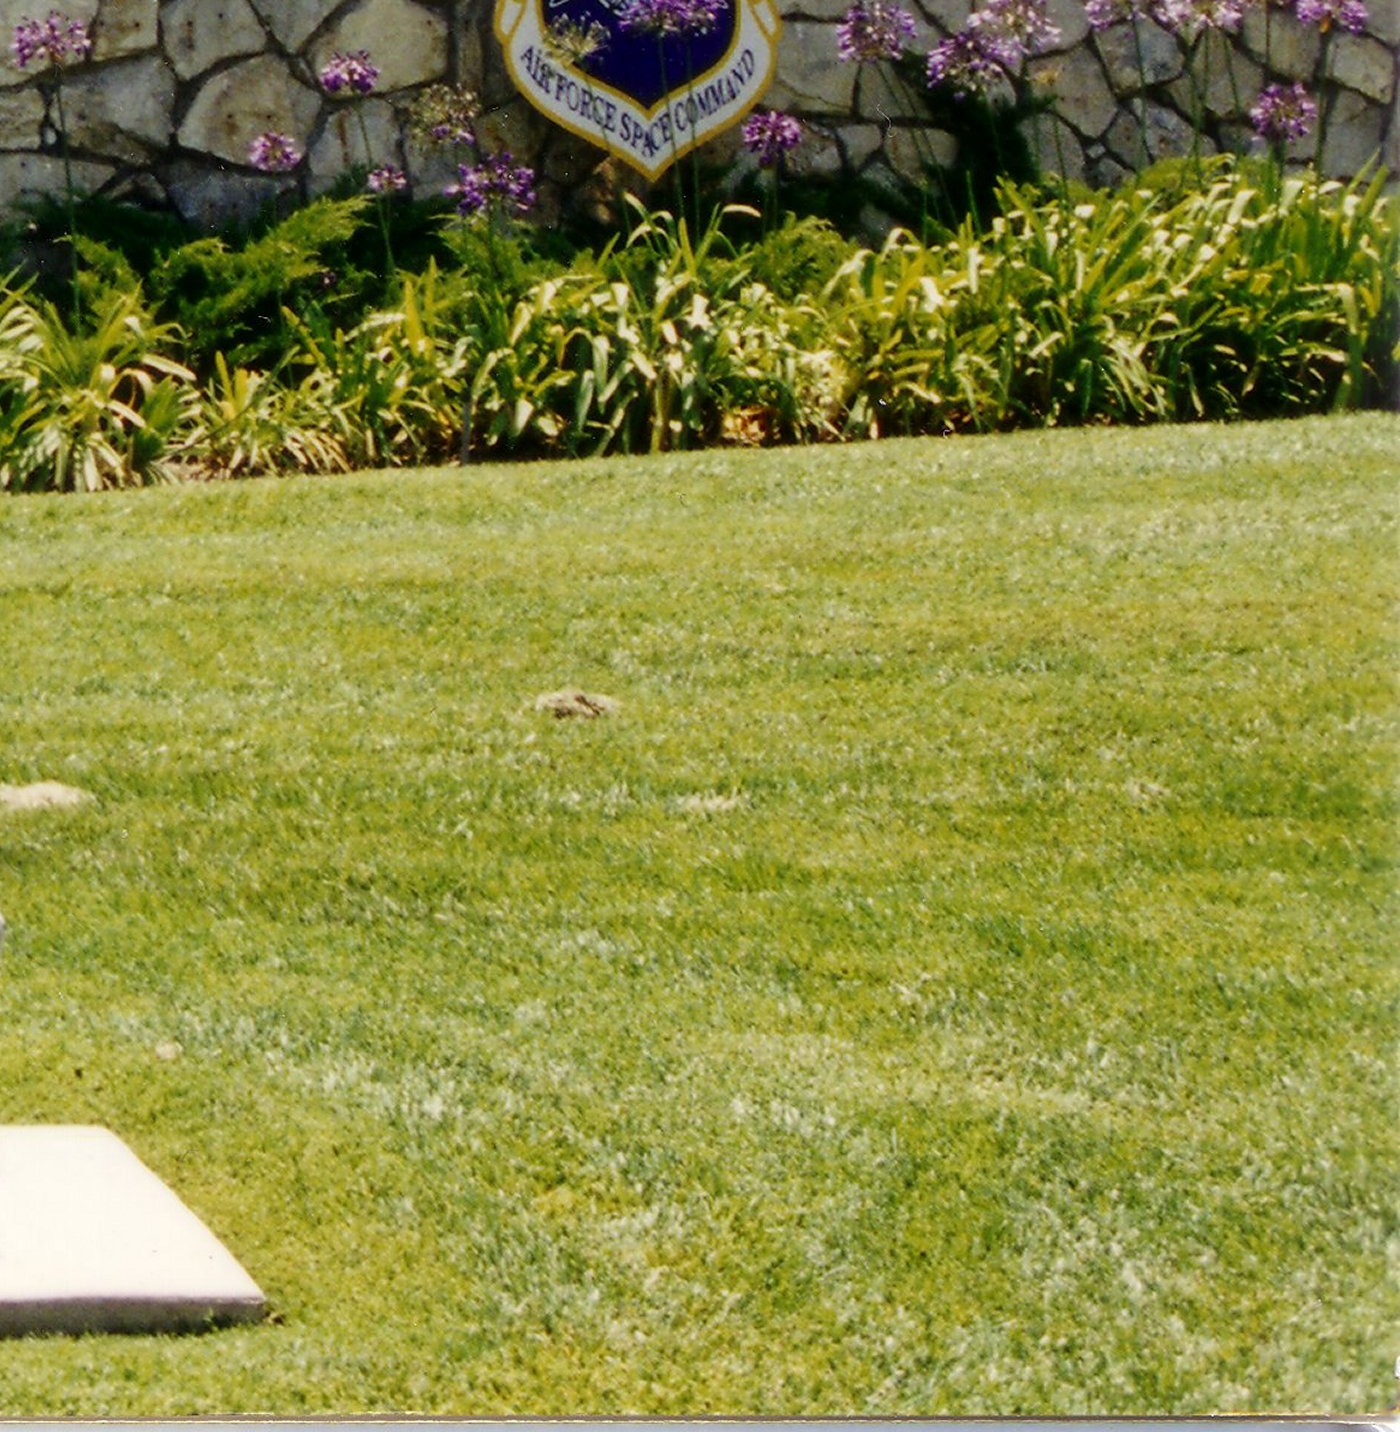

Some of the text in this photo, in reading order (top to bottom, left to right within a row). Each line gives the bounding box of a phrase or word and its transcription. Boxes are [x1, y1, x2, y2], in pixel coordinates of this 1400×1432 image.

[520, 46, 756, 158] AIR FORCE SPACE COMMAND
